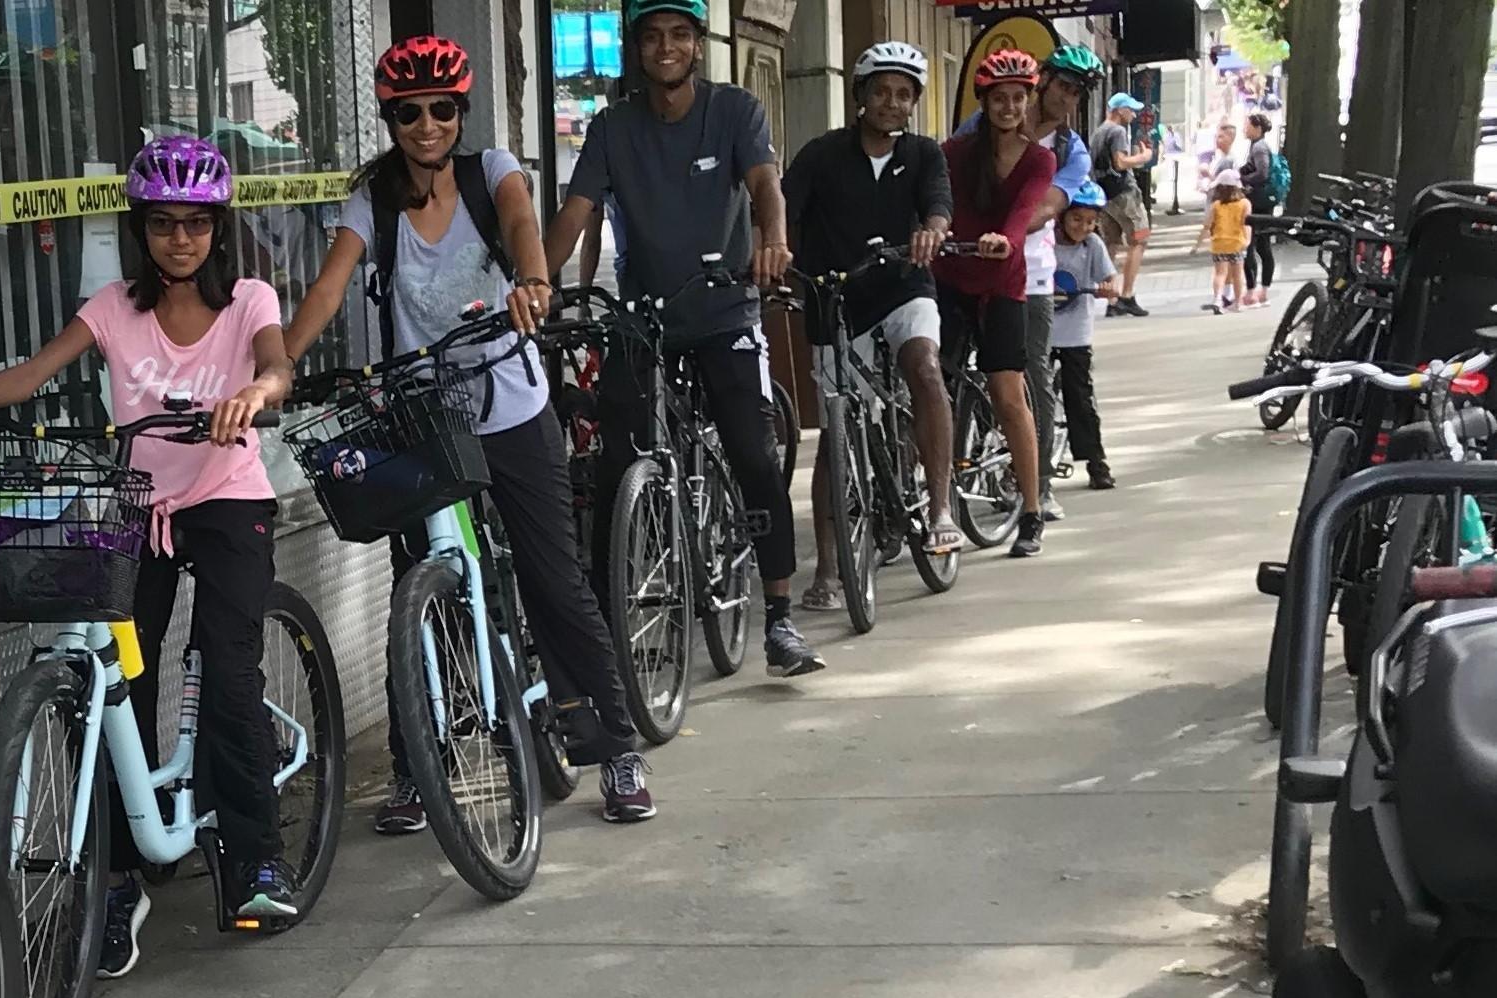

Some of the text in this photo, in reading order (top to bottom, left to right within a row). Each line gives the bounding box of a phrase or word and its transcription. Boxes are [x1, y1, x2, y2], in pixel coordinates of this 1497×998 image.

[12, 187, 67, 219] CAUTION
[77, 182, 126, 212] CAUTION
[238, 180, 277, 203] CAUTION
[283, 179, 318, 201] CAUTION
